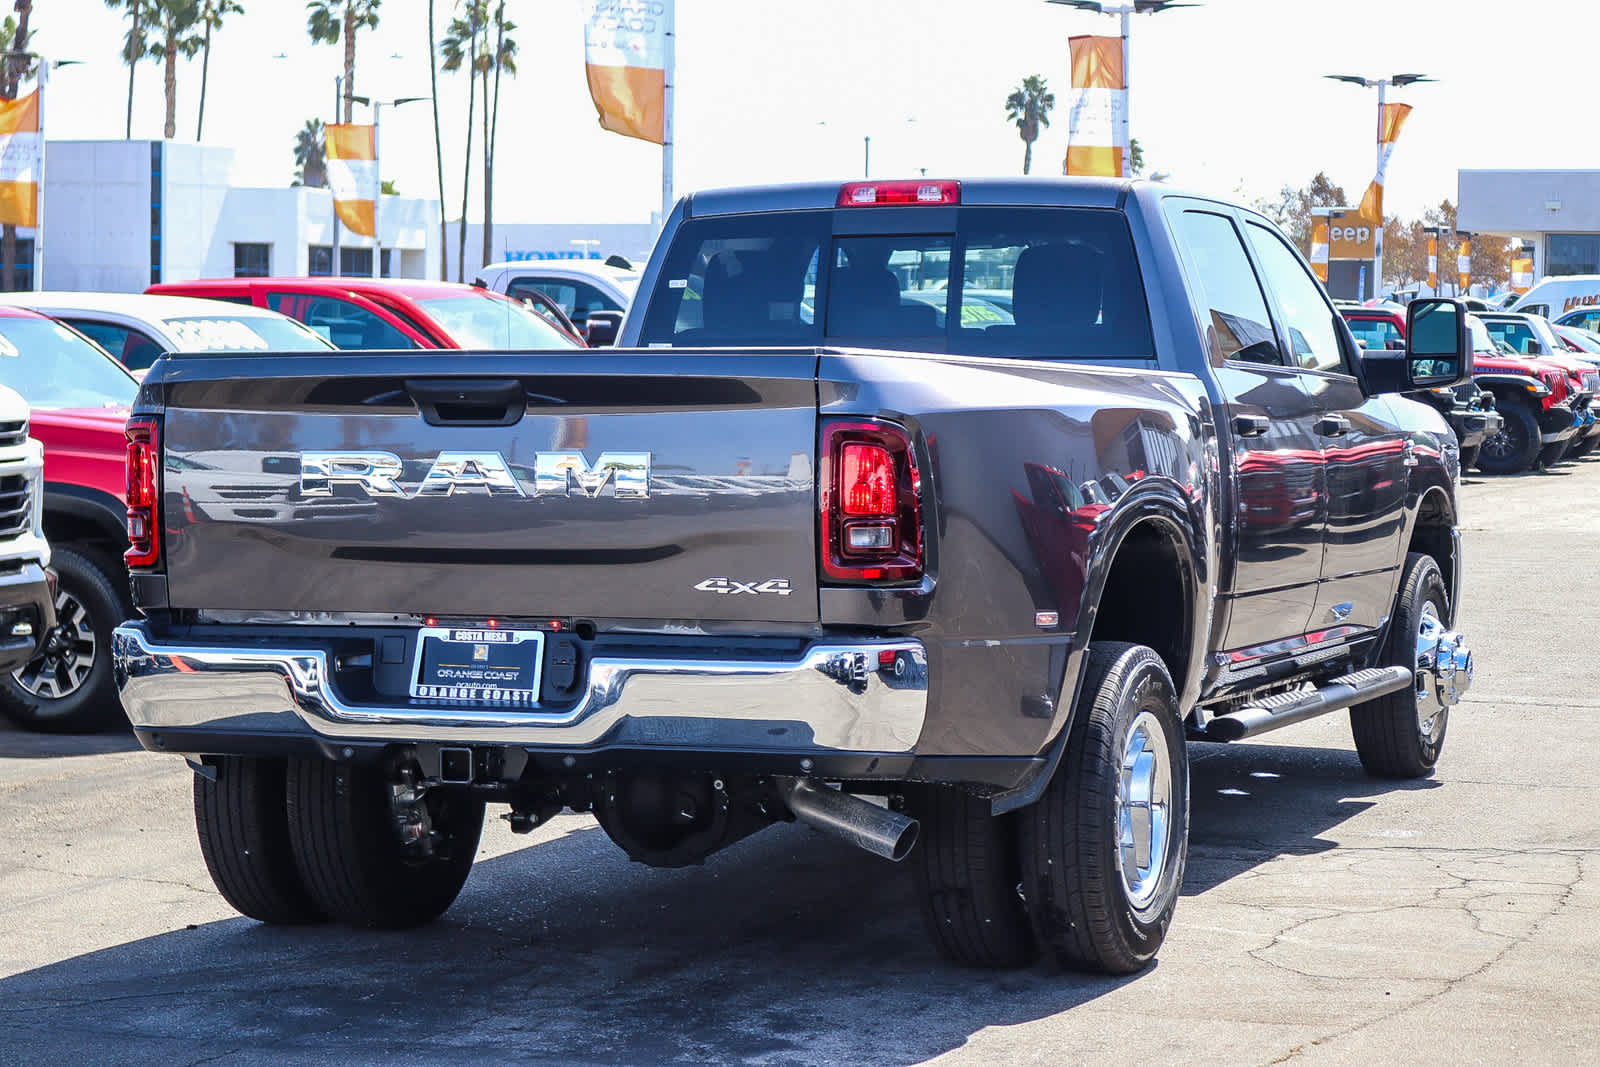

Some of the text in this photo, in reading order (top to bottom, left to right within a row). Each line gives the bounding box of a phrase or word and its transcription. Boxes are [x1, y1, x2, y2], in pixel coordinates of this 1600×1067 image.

[1330, 226, 1370, 244] eep
[299, 450, 652, 499] RAM
[693, 577, 793, 596] 4x4
[455, 631, 507, 642] COSTA MESA
[437, 669, 519, 680] ORANGE COAST
[419, 686, 531, 701] ORANGE COAST
